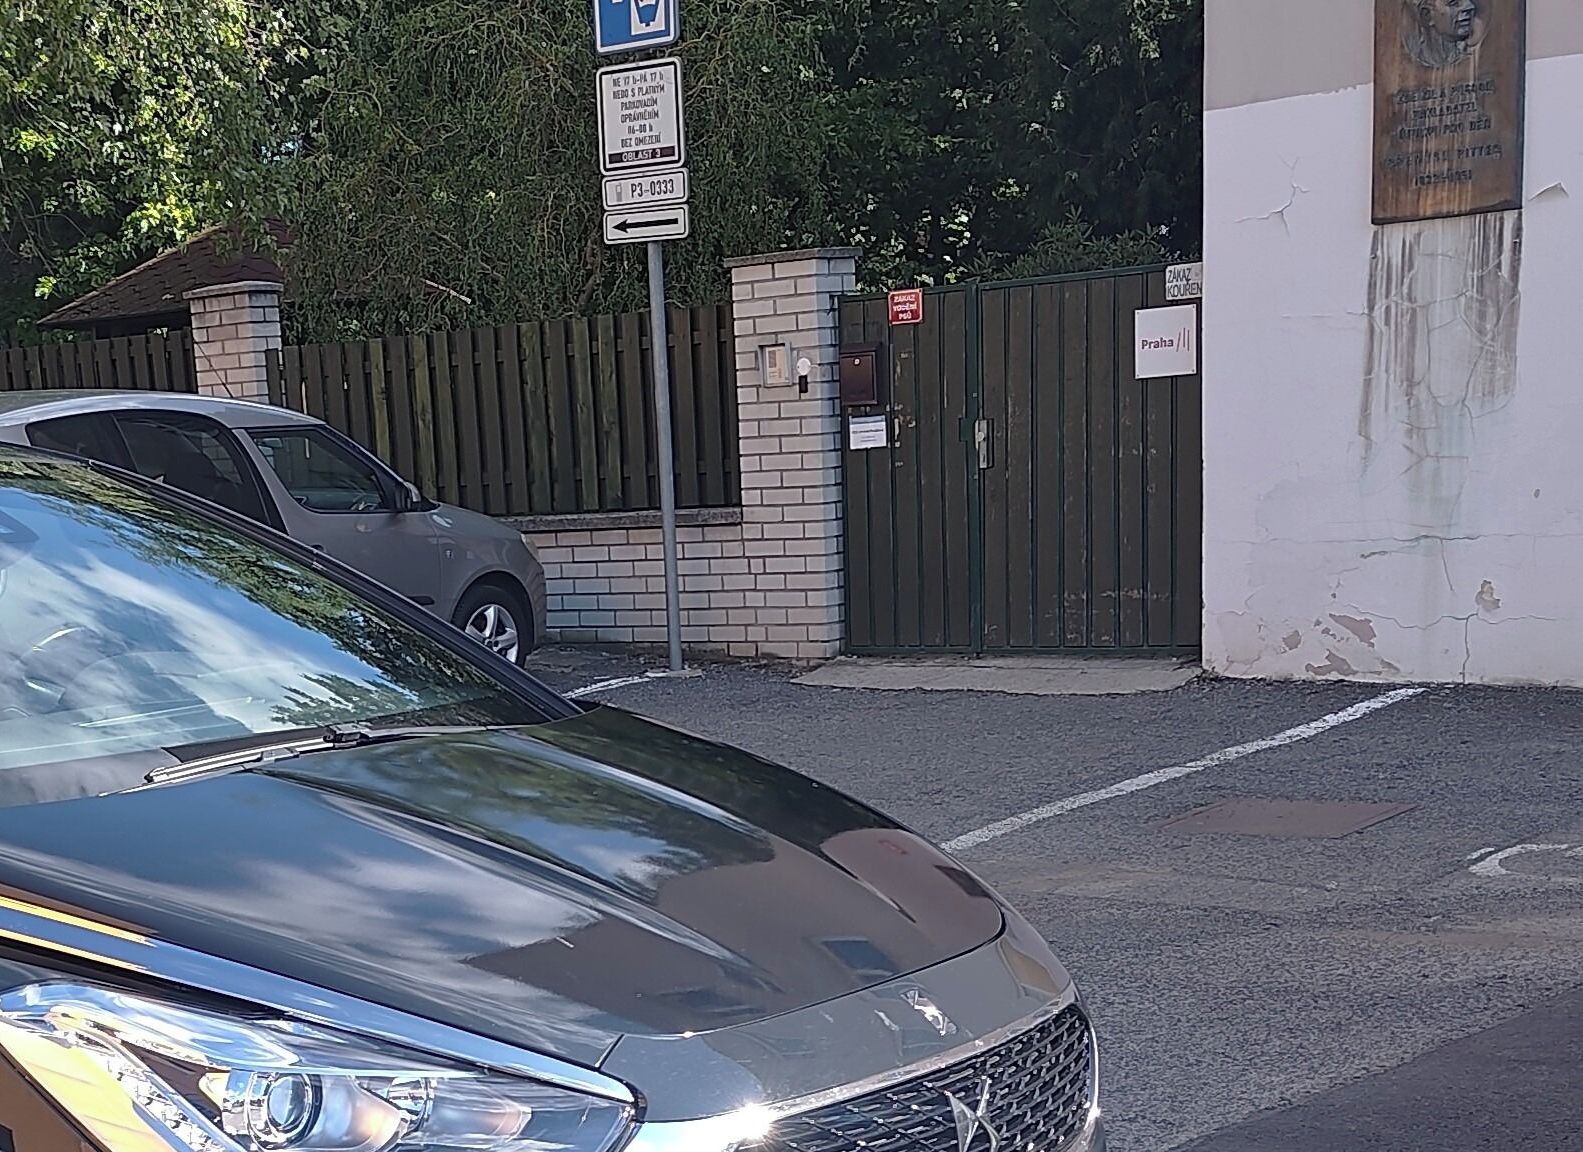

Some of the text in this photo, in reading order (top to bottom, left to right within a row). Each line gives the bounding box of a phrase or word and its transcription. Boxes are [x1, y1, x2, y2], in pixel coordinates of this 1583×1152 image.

[650, 72, 657, 82] 17
[630, 87, 636, 98] S
[622, 149, 661, 161] OBLAST 3
[630, 178, 674, 199] P3-0333
[1168, 267, 1192, 283] ZÁKAZ
[1141, 336, 1174, 350] Praha
